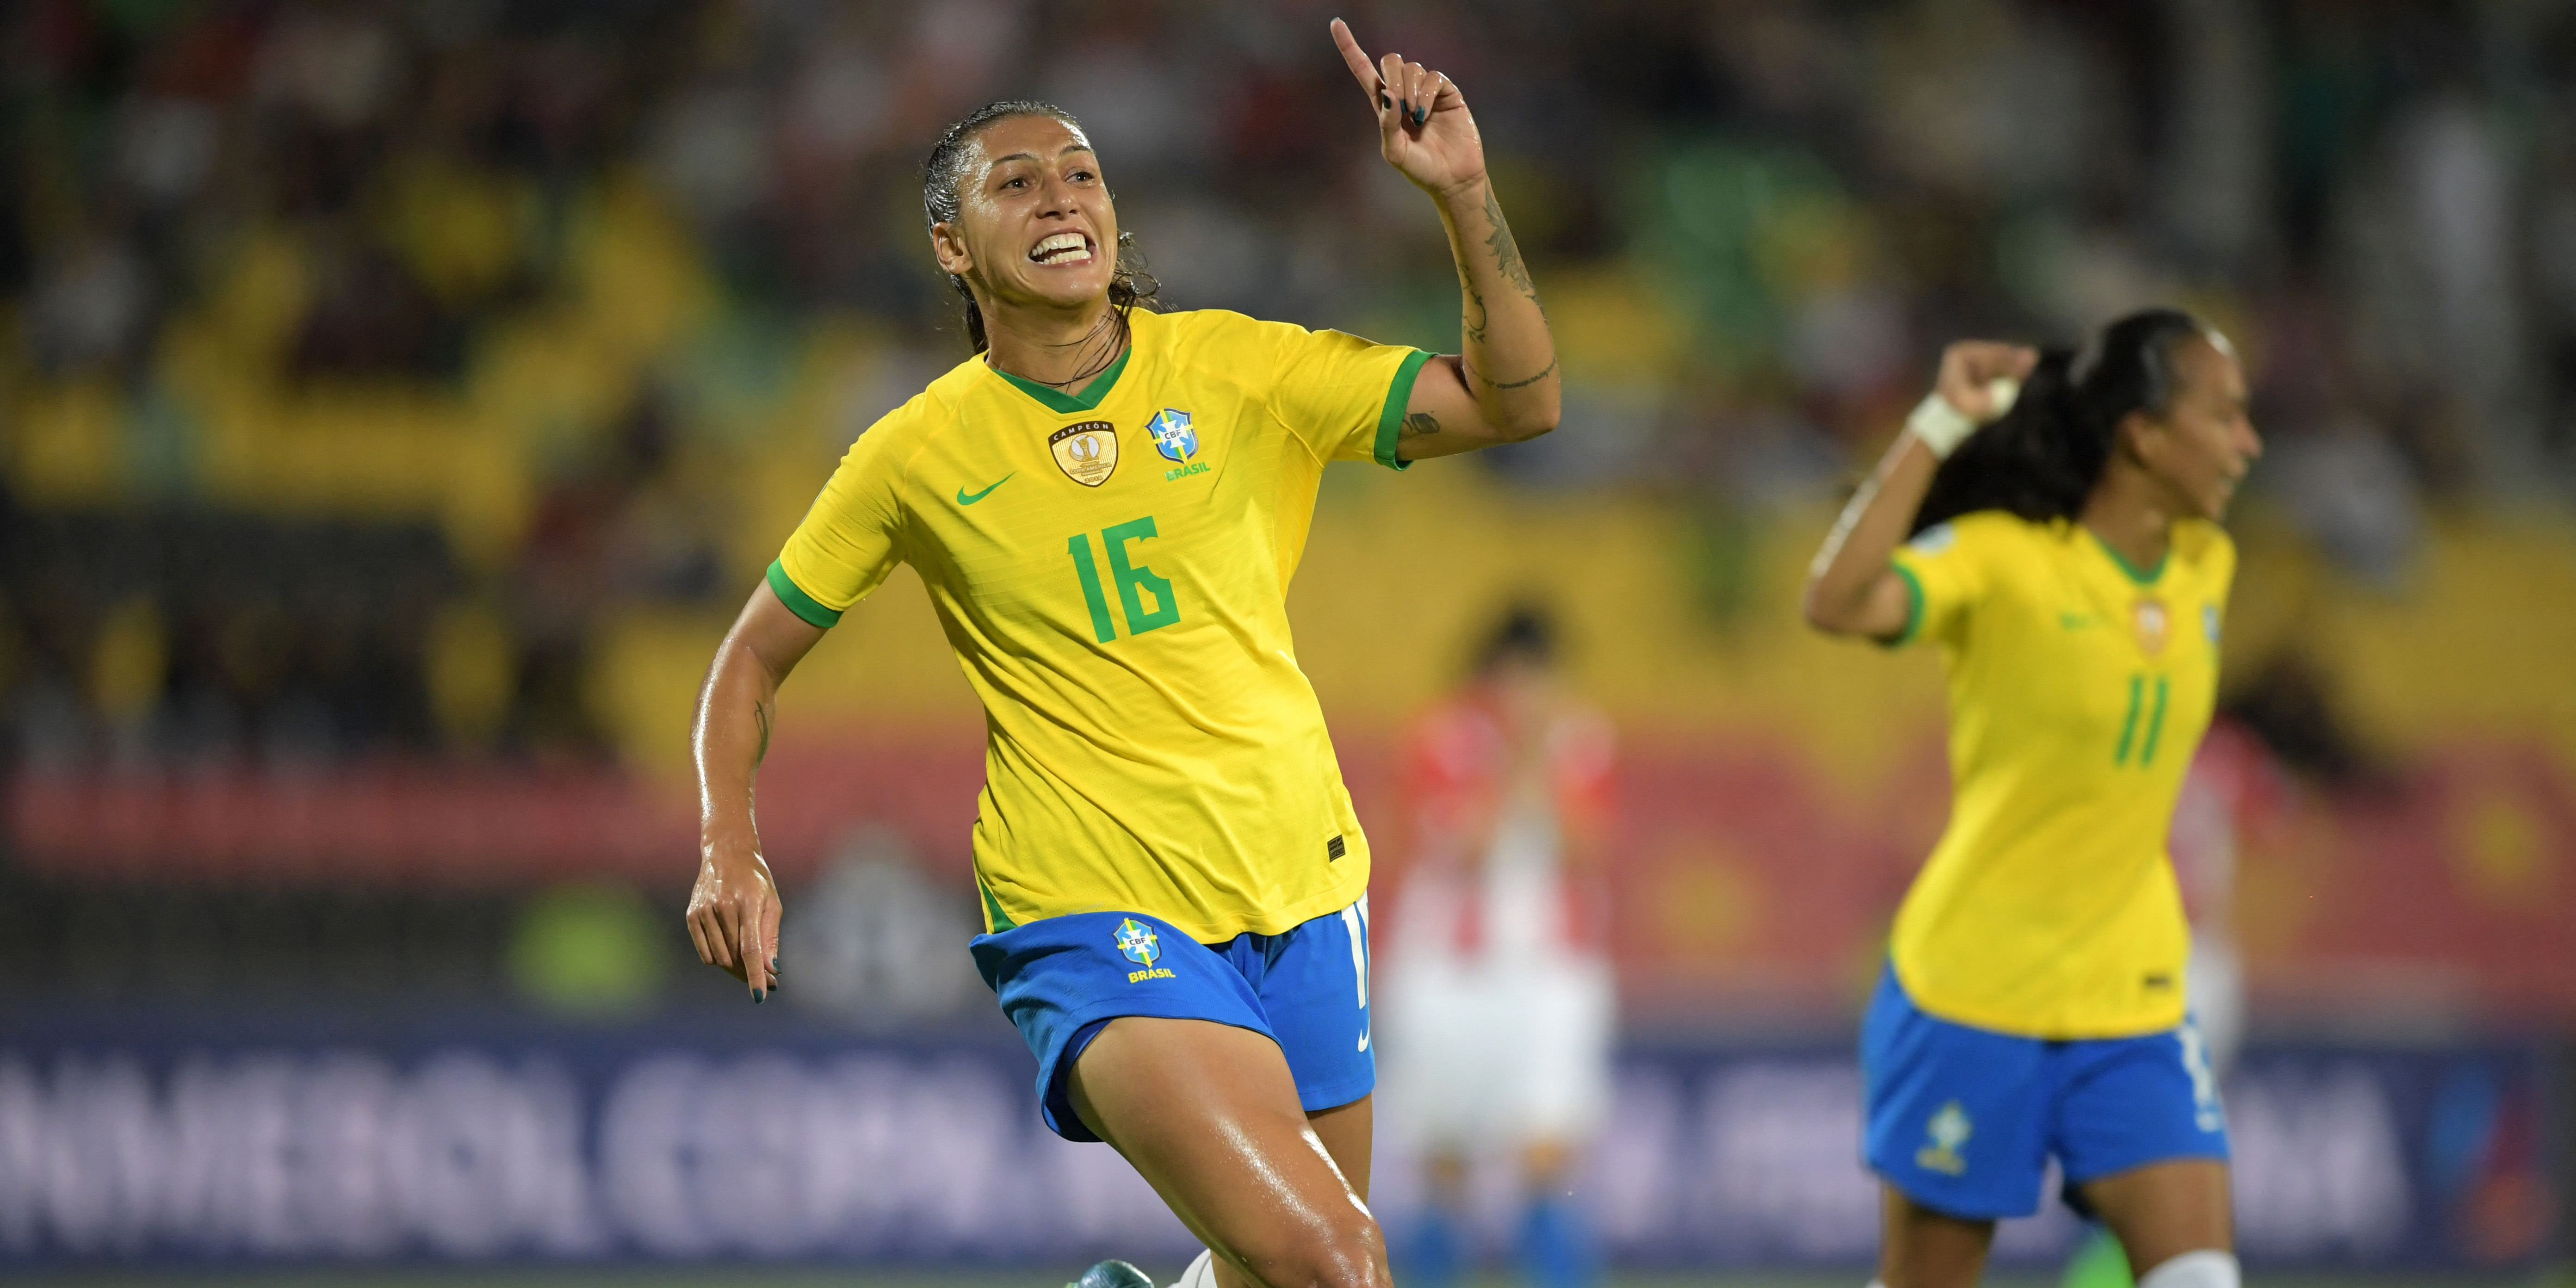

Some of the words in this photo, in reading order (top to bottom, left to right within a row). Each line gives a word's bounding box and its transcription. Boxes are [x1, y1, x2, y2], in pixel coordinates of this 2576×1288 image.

[1053, 422, 1108, 440] CAMPEÓN
[1164, 429, 1181, 440] CBF
[1164, 462, 1211, 482] BRASIL
[1068, 515, 1181, 644] 16
[2112, 673, 2171, 768] 11
[1129, 937, 1146, 945] CBF
[1128, 968, 1176, 984] BRASIL
